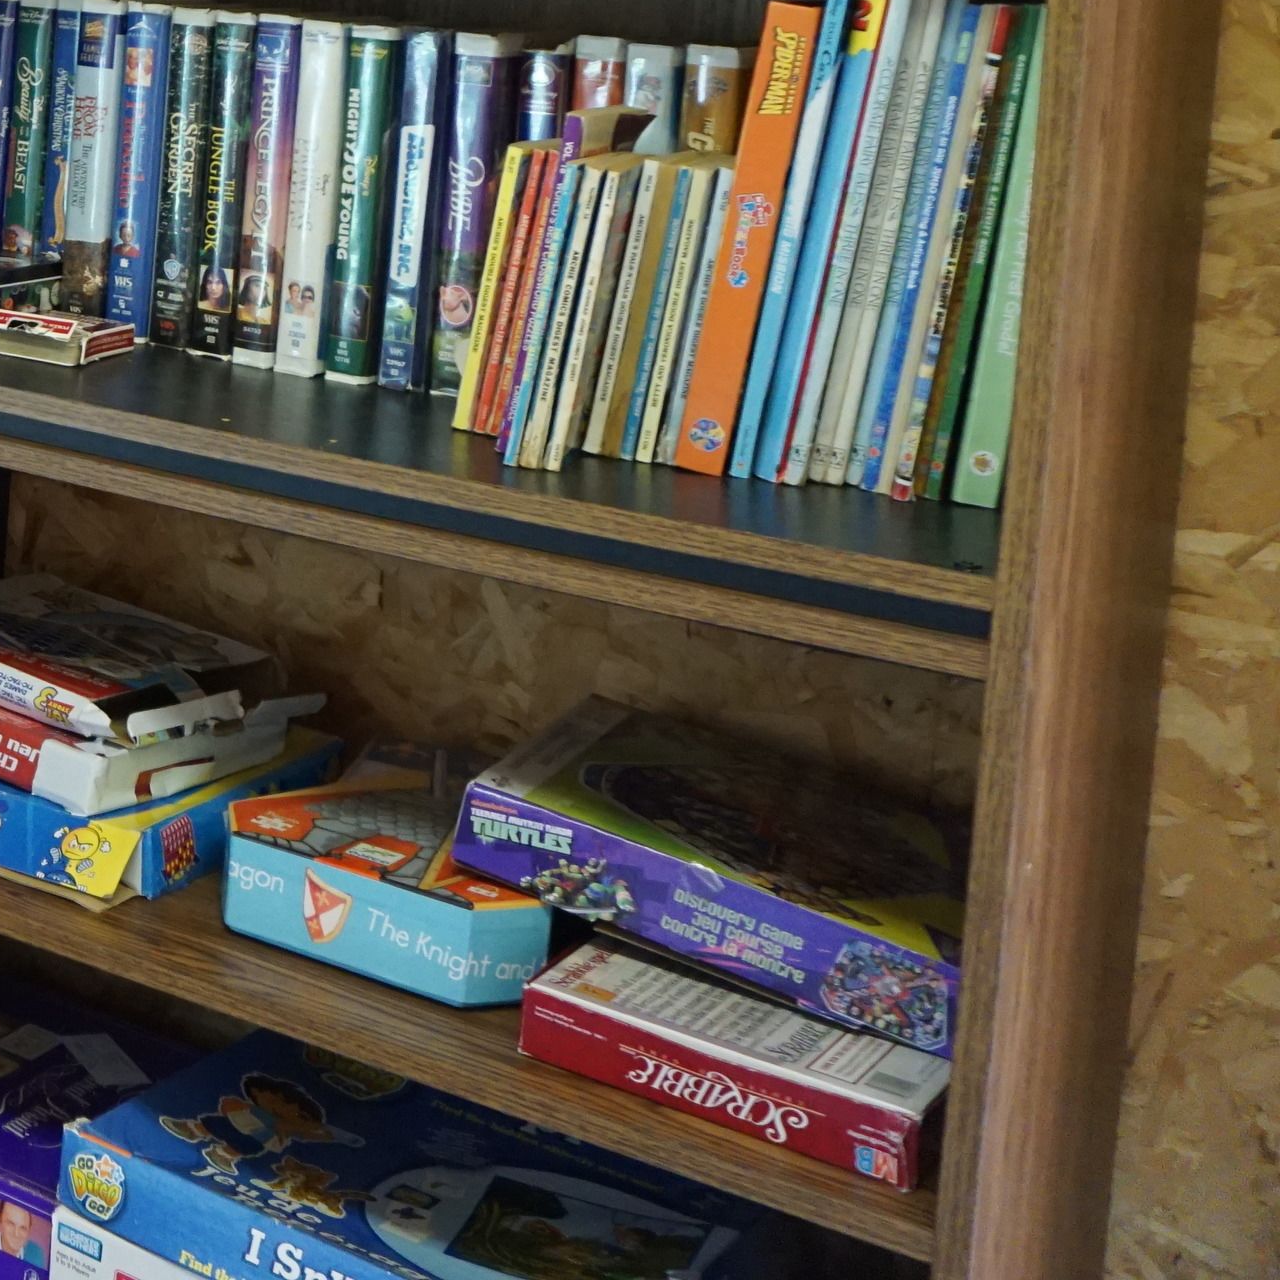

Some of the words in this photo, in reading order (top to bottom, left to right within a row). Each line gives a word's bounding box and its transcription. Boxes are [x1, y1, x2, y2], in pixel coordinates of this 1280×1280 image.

[852, 0, 872, 31] 2
[16, 57, 45, 120] Beauty
[253, 76, 279, 161] PRINCE
[345, 88, 361, 152] MIGHTY
[13, 140, 31, 193] BEAST
[167, 112, 188, 196] GARDEN
[179, 124, 198, 197] SECRET
[206, 126, 221, 195] JUNGLE
[341, 149, 359, 194] JOE
[224, 178, 237, 202] THE
[203, 199, 219, 252] BOOK
[336, 193, 353, 260] YOUNG
[568, 251, 581, 280] ARCHIE
[558, 283, 572, 316] COMICS
[551, 321, 564, 353] DIGEST
[540, 357, 557, 402] MAGAZINE
[8, 738, 42, 763] Jeu
[471, 816, 574, 856] TURTLES
[368, 907, 409, 949] The
[415, 931, 492, 981] Knight
[495, 959, 535, 982] and
[724, 925, 785, 960] course
[741, 948, 807, 984] montre
[627, 1055, 810, 1145] SCRABBLE
[77, 1156, 96, 1170] GO
[88, 1198, 113, 1217] GO!
